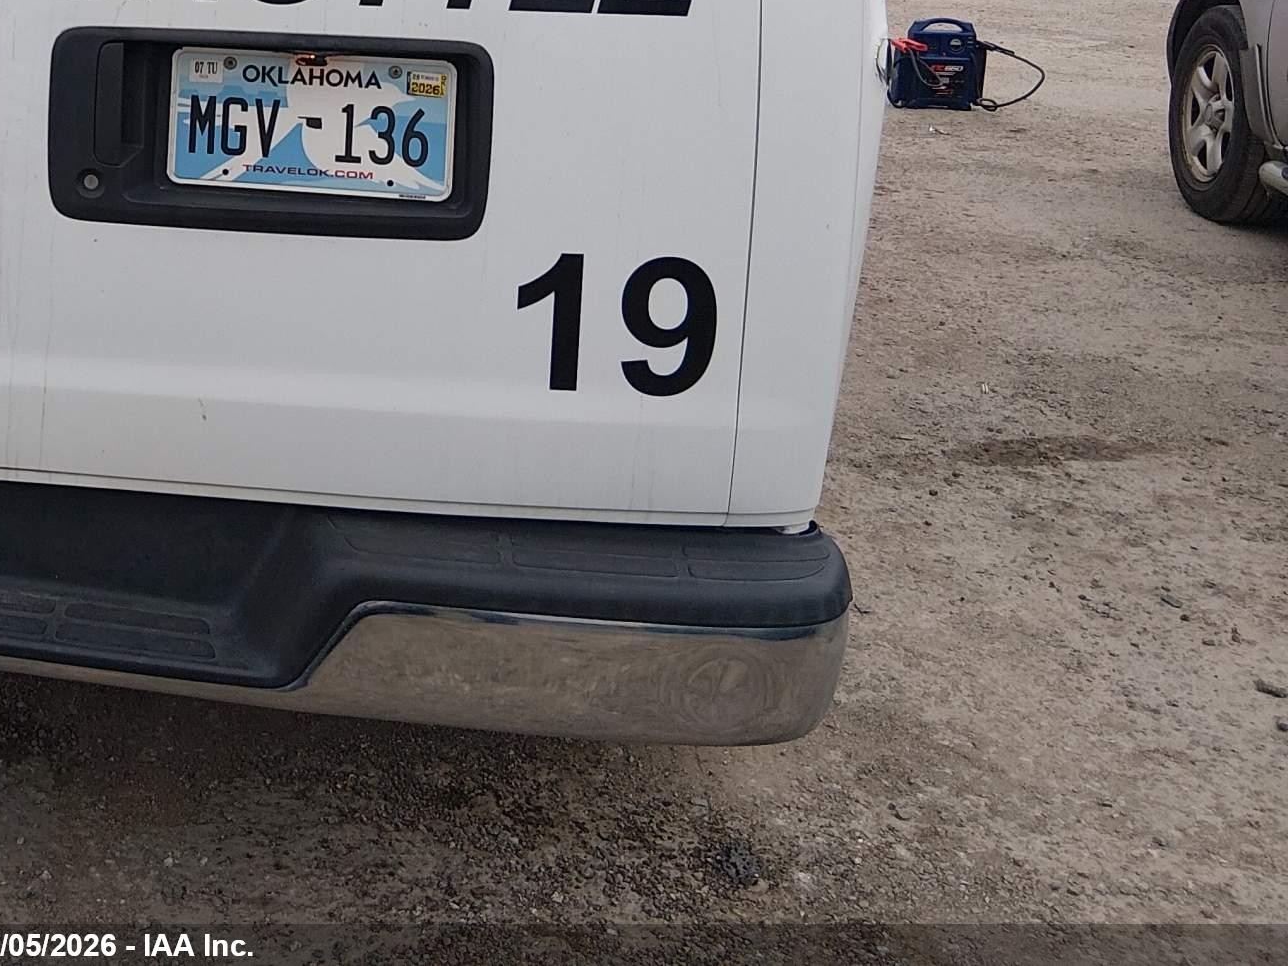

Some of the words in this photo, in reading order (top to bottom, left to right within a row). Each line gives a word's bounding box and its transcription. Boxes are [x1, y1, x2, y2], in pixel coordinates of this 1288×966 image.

[241, 63, 382, 90] OKLAHOMA
[411, 81, 441, 96] 2026
[187, 94, 281, 159] MGV
[333, 103, 430, 169] 136
[242, 163, 374, 180] TRAVELOK.COM
[516, 251, 718, 397] 19
